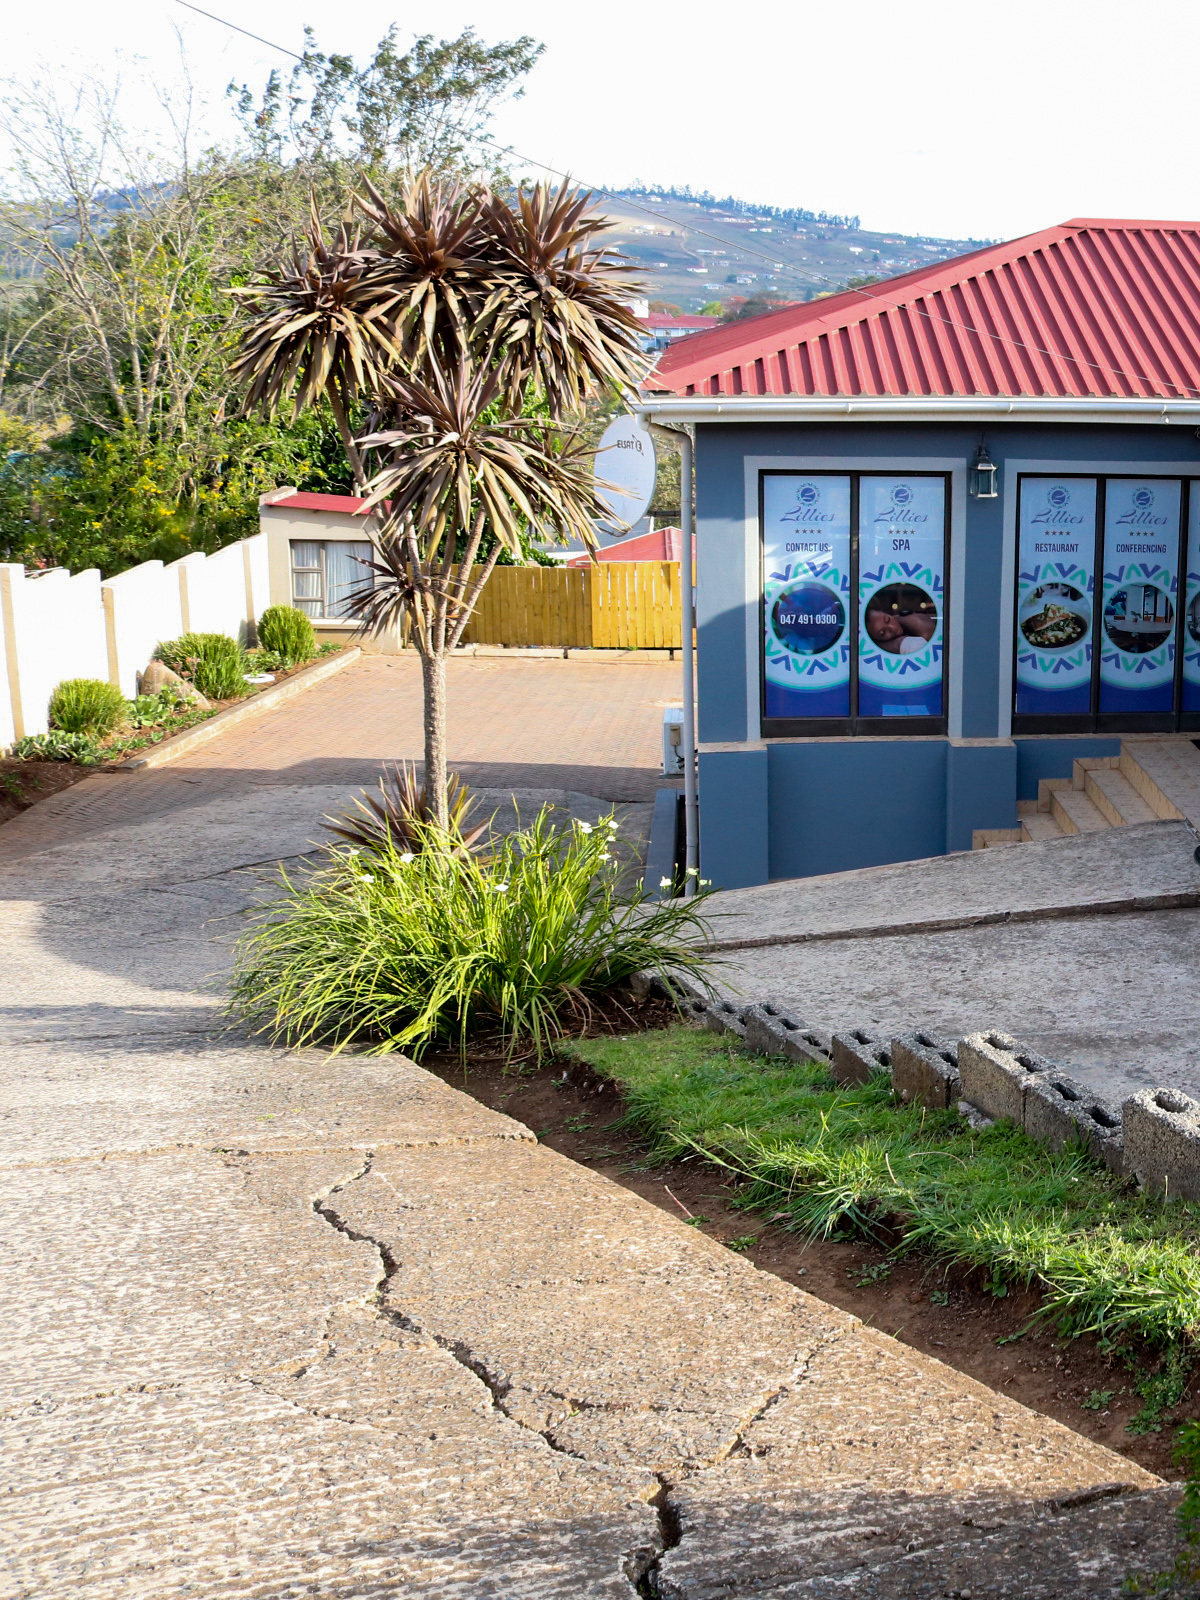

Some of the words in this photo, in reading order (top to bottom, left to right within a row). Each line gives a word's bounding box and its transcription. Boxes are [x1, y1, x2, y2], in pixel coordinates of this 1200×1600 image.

[780, 506, 835, 522] Lillies
[874, 507, 928, 523] Lillies
[1031, 508, 1084, 524] Lillies
[1116, 509, 1168, 525] Lillies
[785, 543, 817, 552] CONTACT
[820, 543, 831, 551] US:
[892, 539, 910, 551] SPA
[1035, 543, 1079, 553] RESTAURANT
[1116, 544, 1167, 553] CONFERENCING
[780, 614, 796, 624] 047
[798, 614, 814, 624] 491
[815, 614, 837, 624] 0300
